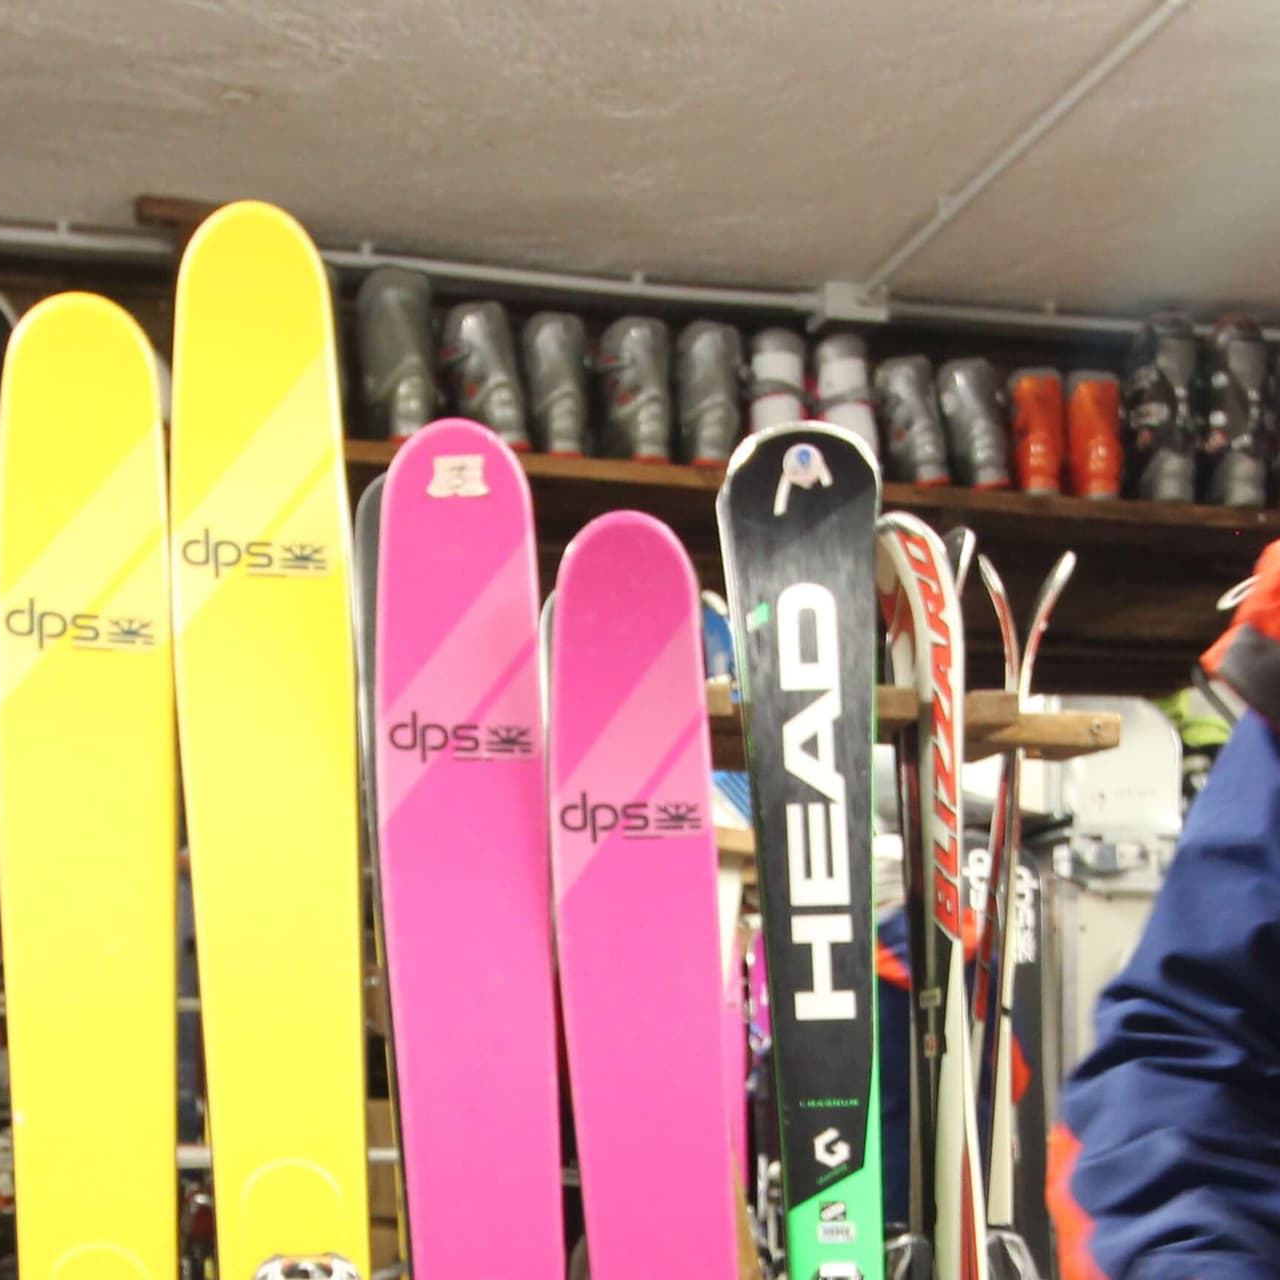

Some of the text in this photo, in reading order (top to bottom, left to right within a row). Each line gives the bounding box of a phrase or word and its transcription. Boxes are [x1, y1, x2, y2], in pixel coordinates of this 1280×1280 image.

[182, 528, 274, 579] dps
[5, 598, 100, 650] dps
[388, 711, 480, 762] dps
[896, 528, 962, 940] BLIZZARD
[560, 792, 650, 843] dps
[775, 582, 858, 1021] HEAD
